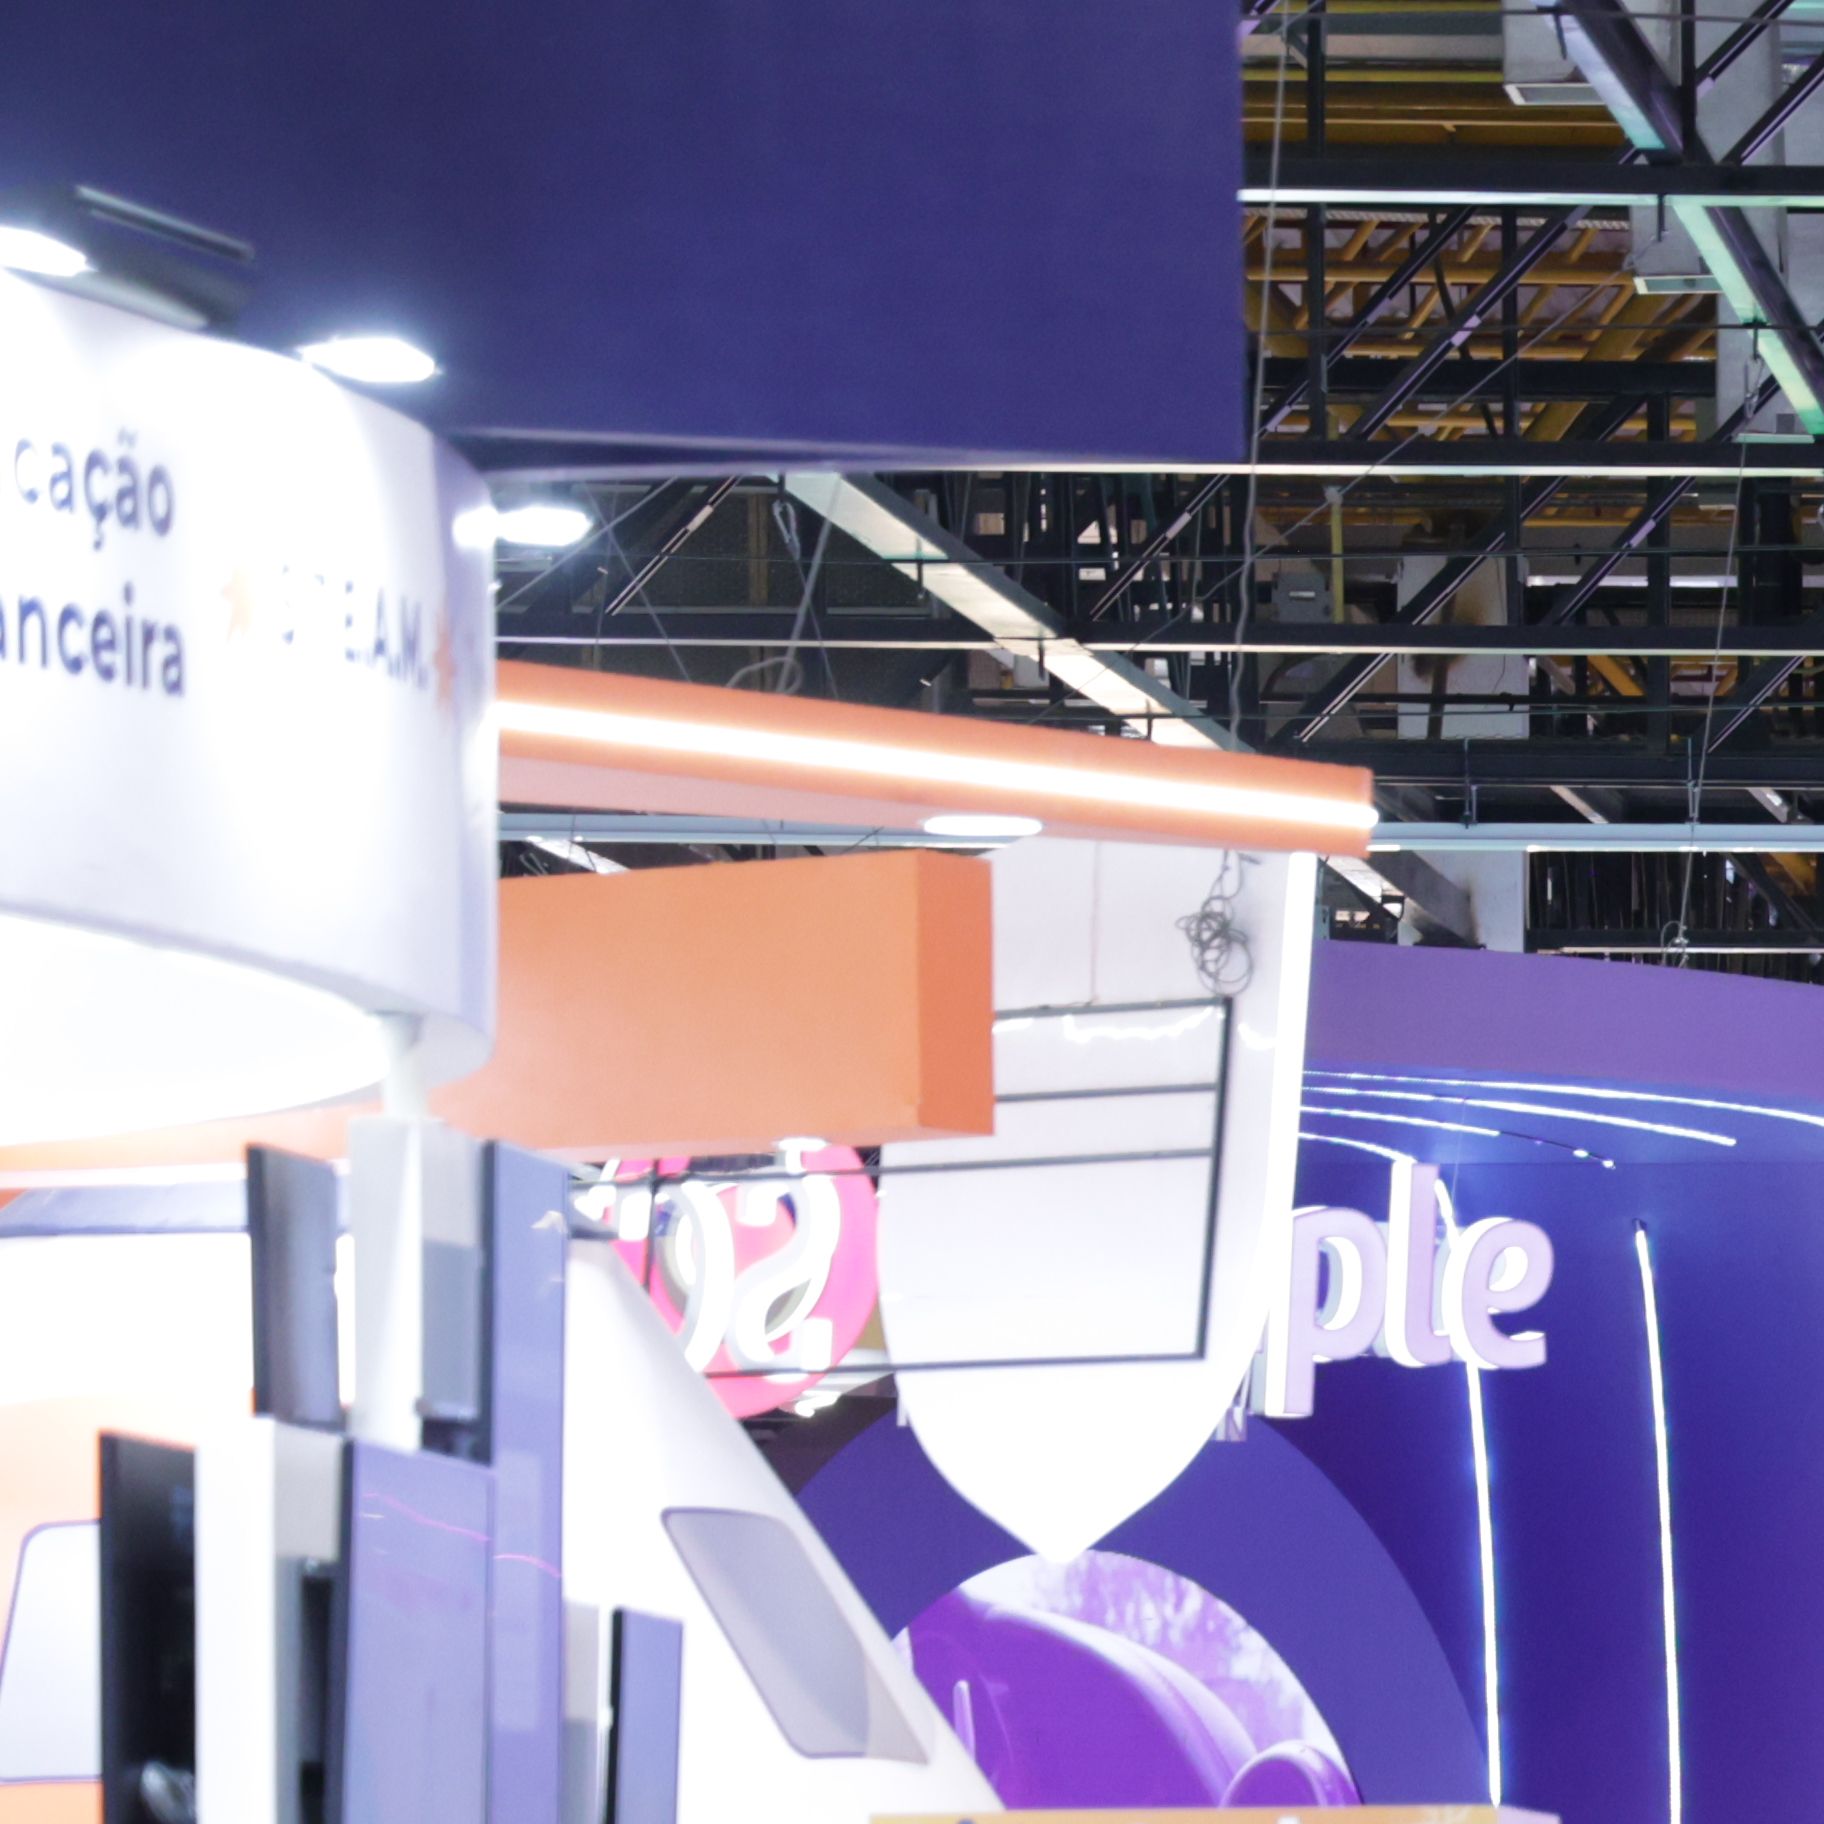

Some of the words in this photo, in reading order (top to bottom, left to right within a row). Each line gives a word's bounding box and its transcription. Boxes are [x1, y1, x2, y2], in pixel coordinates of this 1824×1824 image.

[13, 427, 173, 550] cação
[0, 581, 186, 698] nceira
[1252, 1160, 1554, 1418] ple
